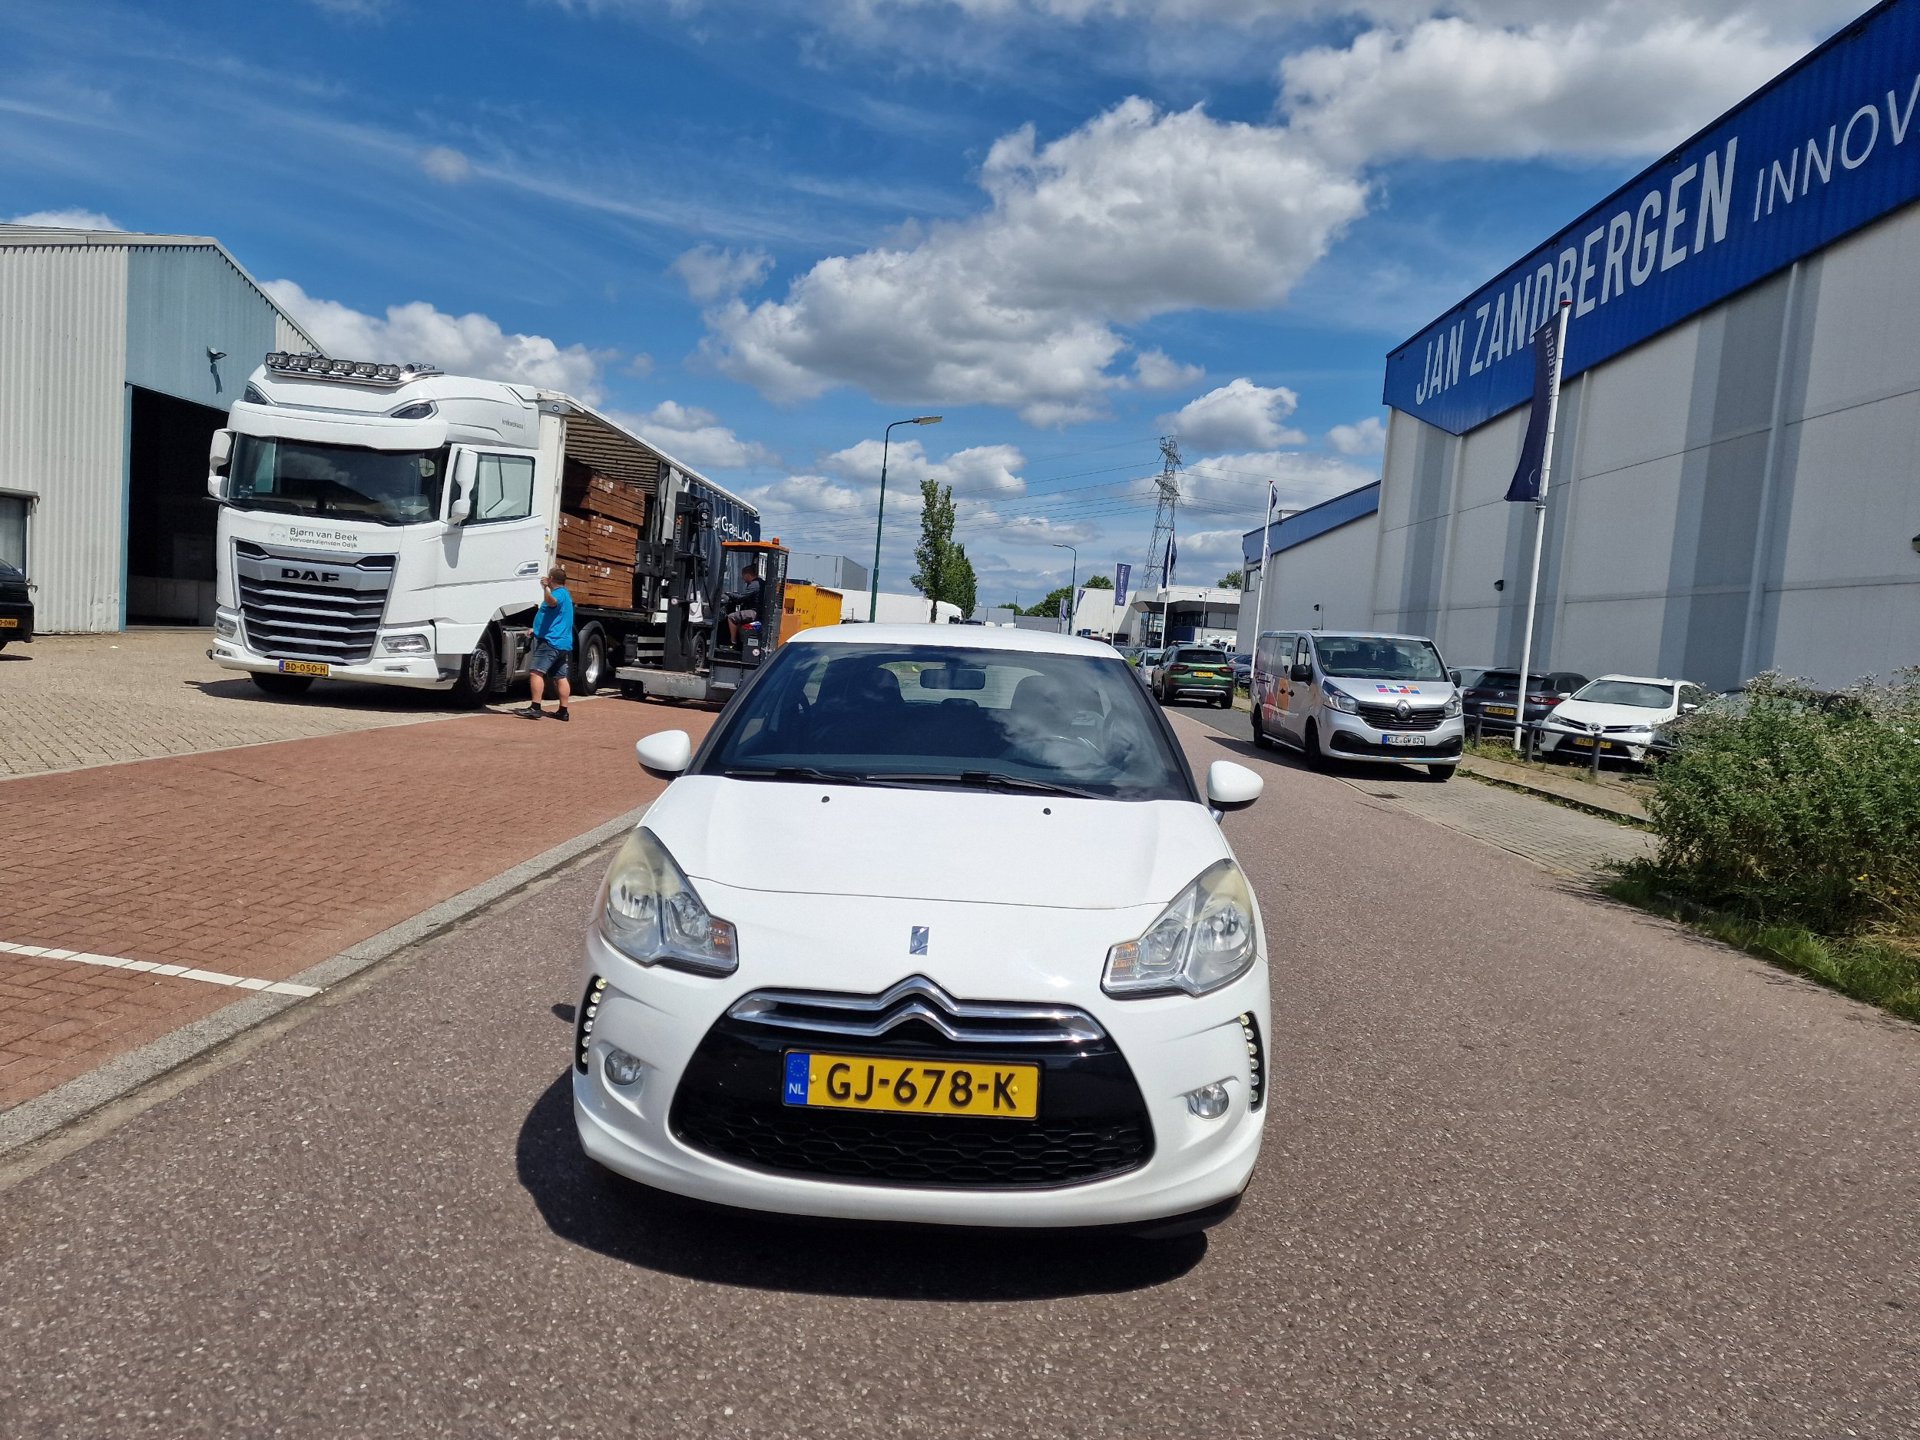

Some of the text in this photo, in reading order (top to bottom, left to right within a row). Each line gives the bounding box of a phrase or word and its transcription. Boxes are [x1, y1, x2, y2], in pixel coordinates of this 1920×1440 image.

[1415, 73, 1920, 405] JAN ZANDBERGEN INNOV
[289, 527, 358, 541] Bjørn van Beek
[281, 567, 340, 583] DAF
[285, 662, 326, 674] BD-050-H
[788, 1062, 1017, 1110] NL GJ-678-K
